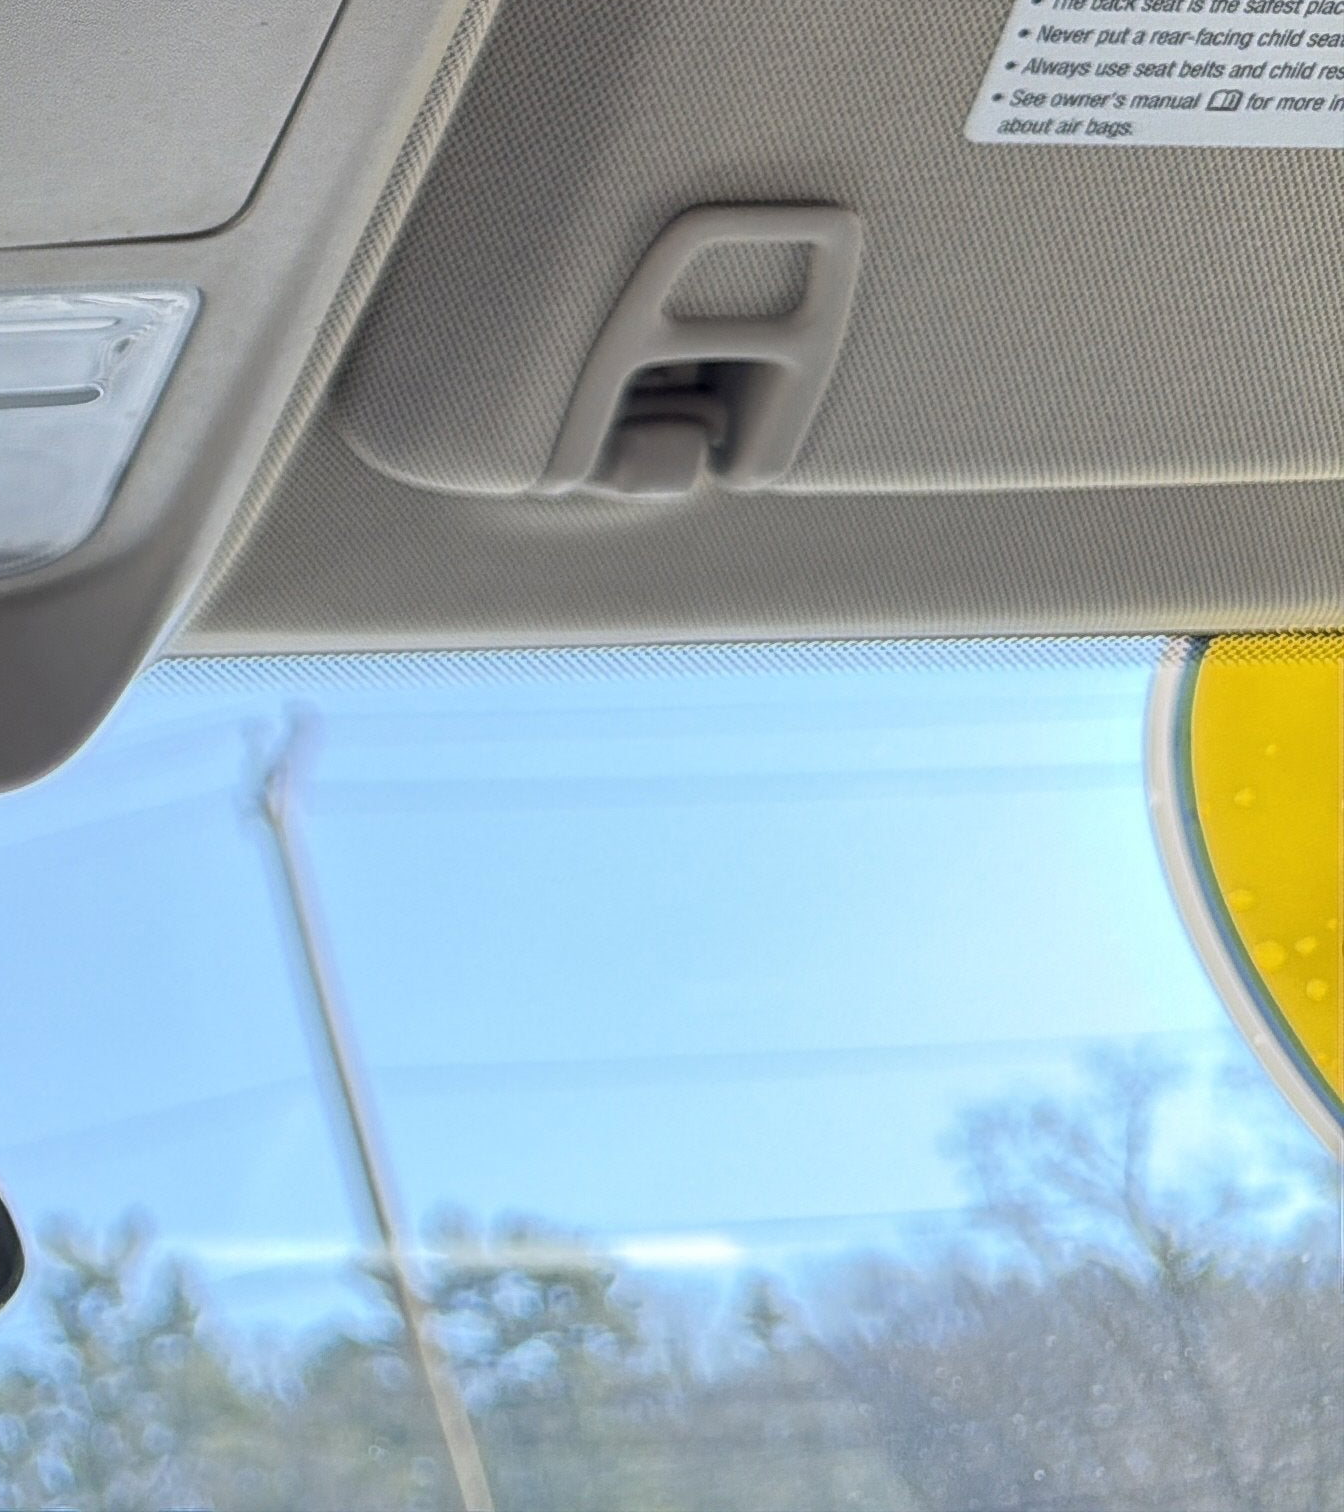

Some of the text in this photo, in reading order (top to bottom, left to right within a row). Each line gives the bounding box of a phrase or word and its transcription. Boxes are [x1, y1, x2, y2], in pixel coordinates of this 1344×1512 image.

[1036, 25, 1093, 43] Never
[1094, 28, 1130, 46] put
[1132, 31, 1146, 45] a
[1149, 28, 1254, 50] rear-facing
[1257, 29, 1306, 47] child
[1021, 58, 1092, 78] Always
[1095, 62, 1131, 77] use
[1133, 61, 1177, 78] seat
[1179, 61, 1226, 79] belts
[1229, 61, 1267, 79] and
[1269, 62, 1316, 80] child
[1010, 89, 1047, 107] See
[1050, 92, 1127, 109] owner's
[1130, 93, 1202, 110] manual
[1245, 93, 1274, 110] for
[1276, 96, 1326, 111] more
[997, 117, 1133, 139] about air bags.
